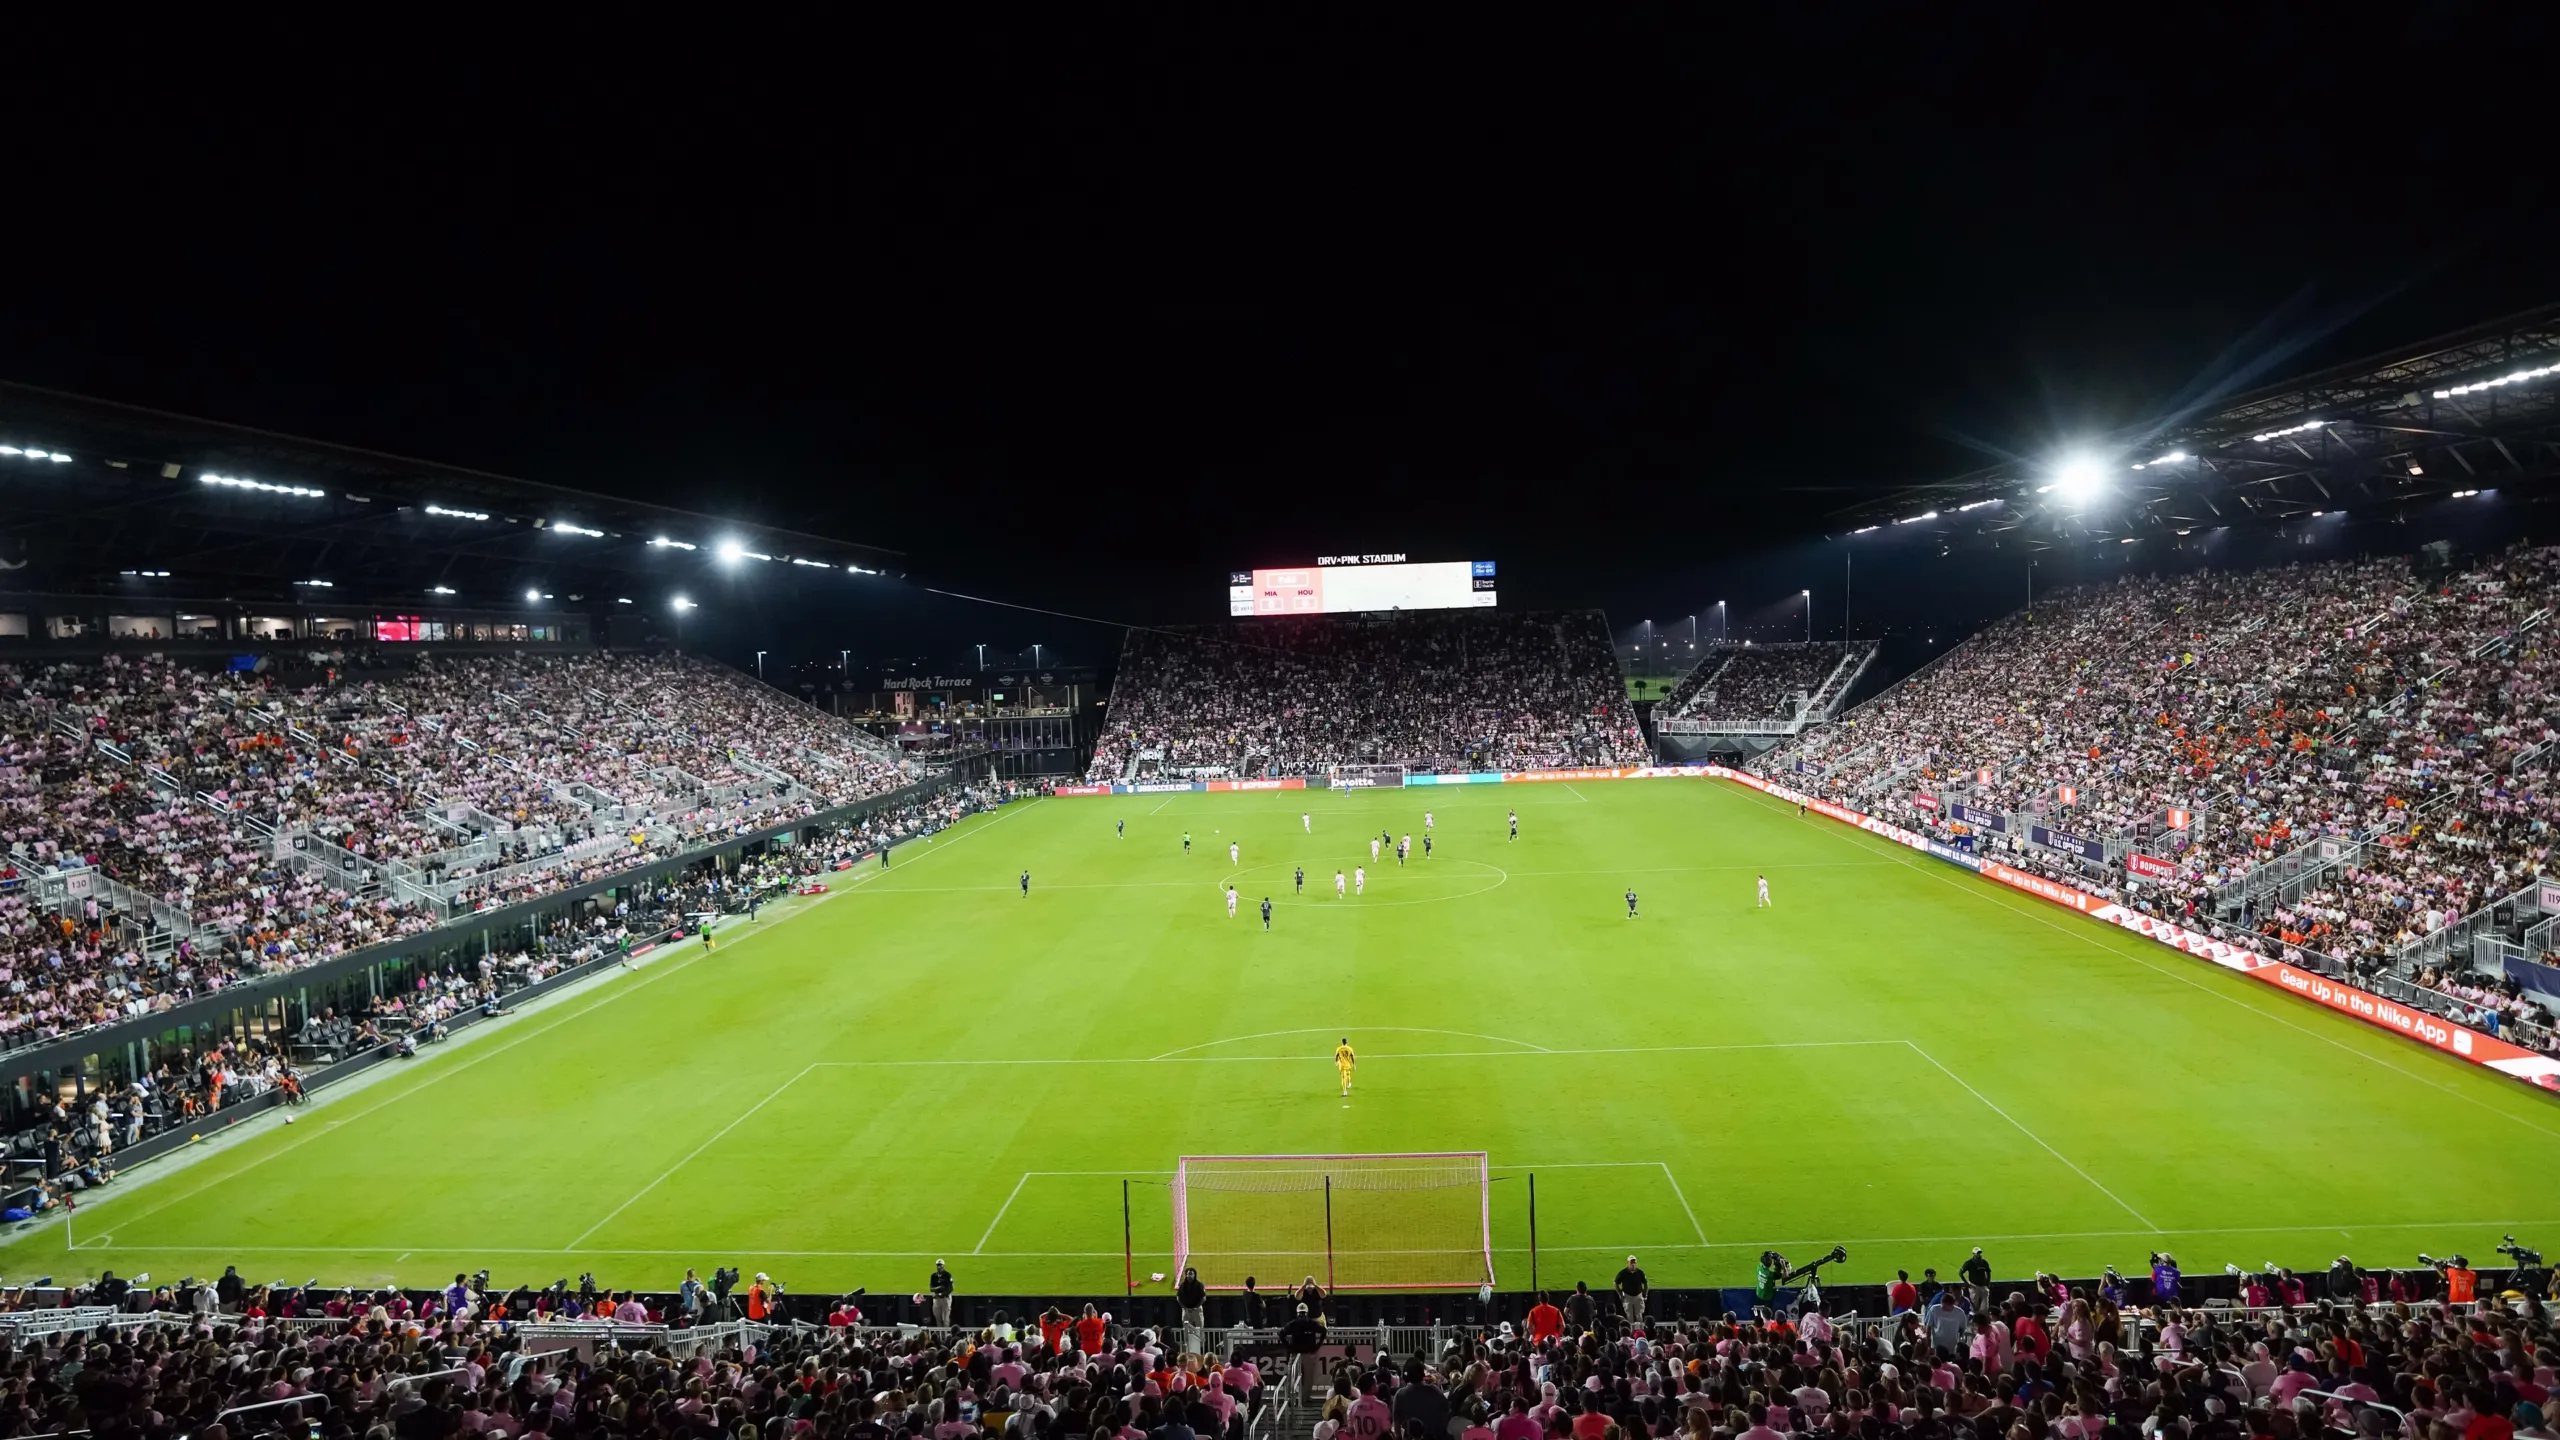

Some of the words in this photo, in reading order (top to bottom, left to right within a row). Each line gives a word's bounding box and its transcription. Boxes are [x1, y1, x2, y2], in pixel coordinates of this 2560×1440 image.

[1362, 554, 1406, 563] STADIUM
[884, 678, 908, 689] Hard
[908, 677, 932, 690] Rock
[934, 676, 972, 688] Terrace
[1137, 784, 1192, 792] USSOCCER.COM
[2075, 845, 2084, 855] CUP
[72, 880, 87, 889] 130
[1997, 867, 2013, 881] Gear
[2014, 873, 2023, 886] Up
[2024, 878, 2031, 888] in
[2031, 879, 2042, 892] the
[2043, 884, 2059, 898] Nike
[2060, 891, 2075, 905] App
[2548, 893, 2560, 904] 119
[2498, 912, 2511, 920] 119
[2280, 968, 2309, 991] Gear
[2312, 980, 2331, 1001] Up
[2334, 990, 2347, 1006] in
[2350, 996, 2373, 1015] the
[2377, 1005, 2411, 1029] Nike
[2414, 1018, 2447, 1044] App
[1249, 1356, 1288, 1376] 125
[1355, 1415, 1376, 1435] 10
